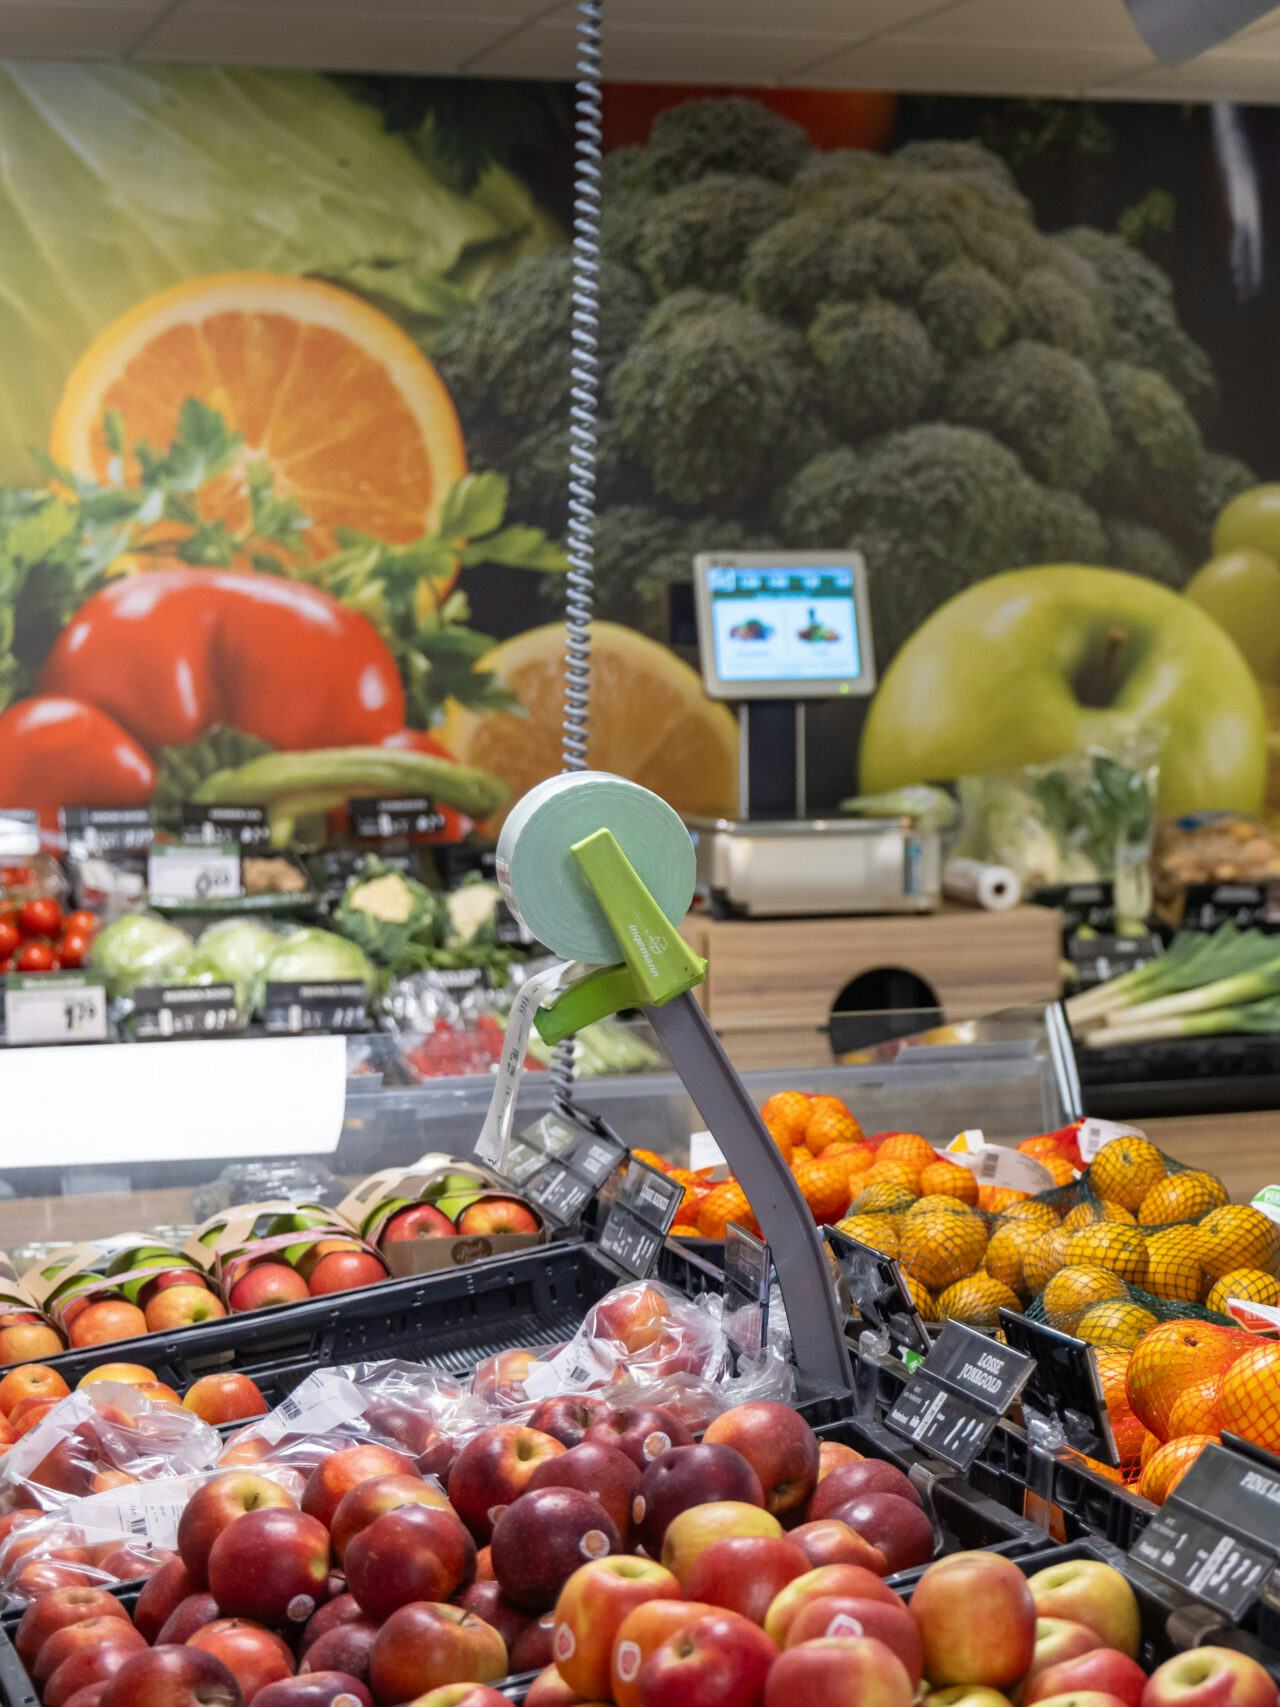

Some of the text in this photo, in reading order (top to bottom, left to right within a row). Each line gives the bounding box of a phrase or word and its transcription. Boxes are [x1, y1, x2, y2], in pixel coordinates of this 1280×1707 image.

[977, 1352, 1004, 1374] LOSSE
[957, 1363, 1002, 1394] JONAGOLD
[1240, 1471, 1271, 1495] PINK
